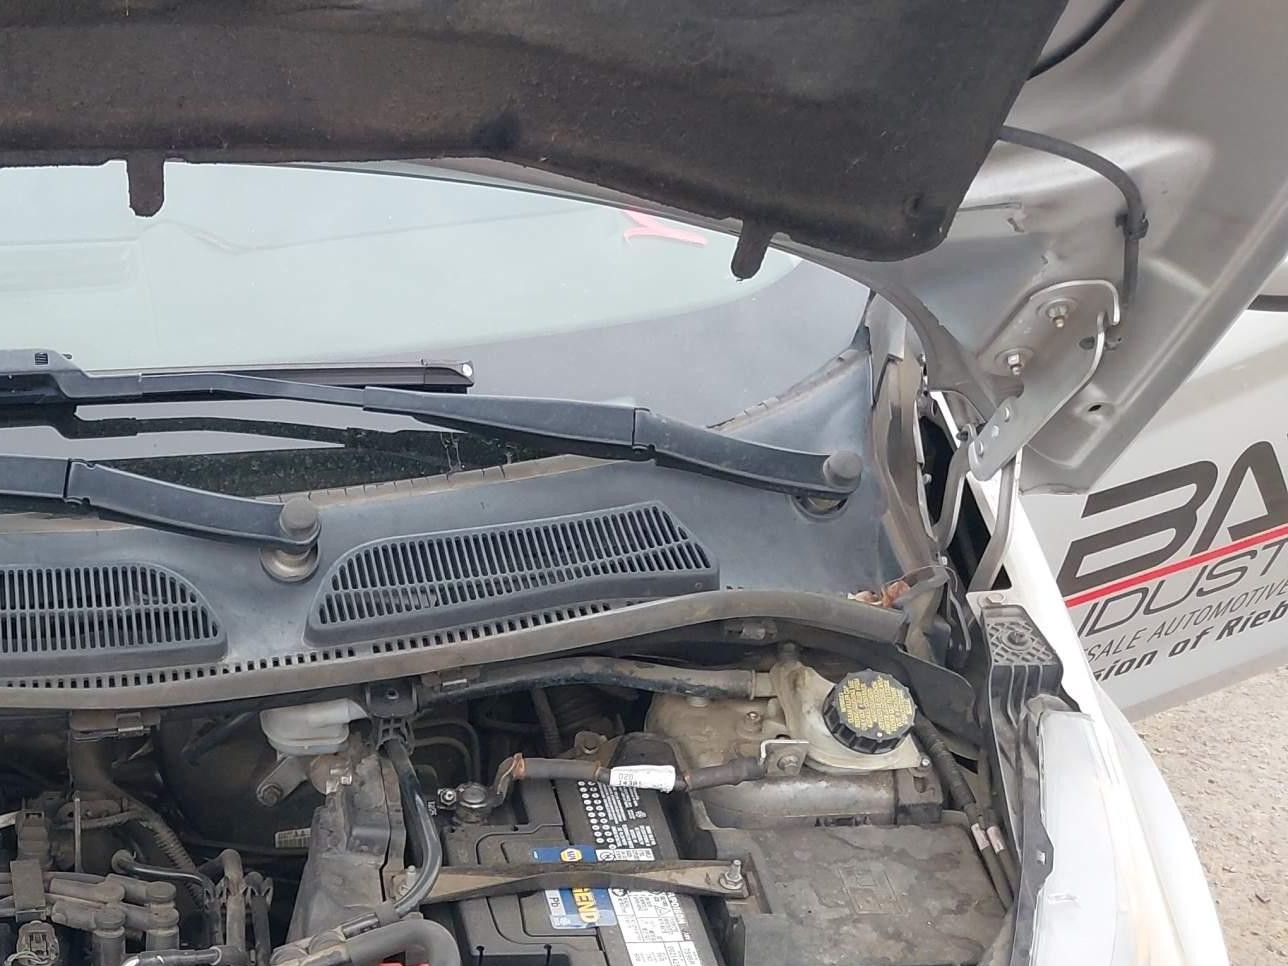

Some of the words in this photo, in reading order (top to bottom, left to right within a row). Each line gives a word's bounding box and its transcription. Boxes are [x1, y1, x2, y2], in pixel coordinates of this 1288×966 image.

[1084, 628, 1145, 664] SALE
[1168, 627, 1213, 657] of
[549, 897, 560, 908] Pb
